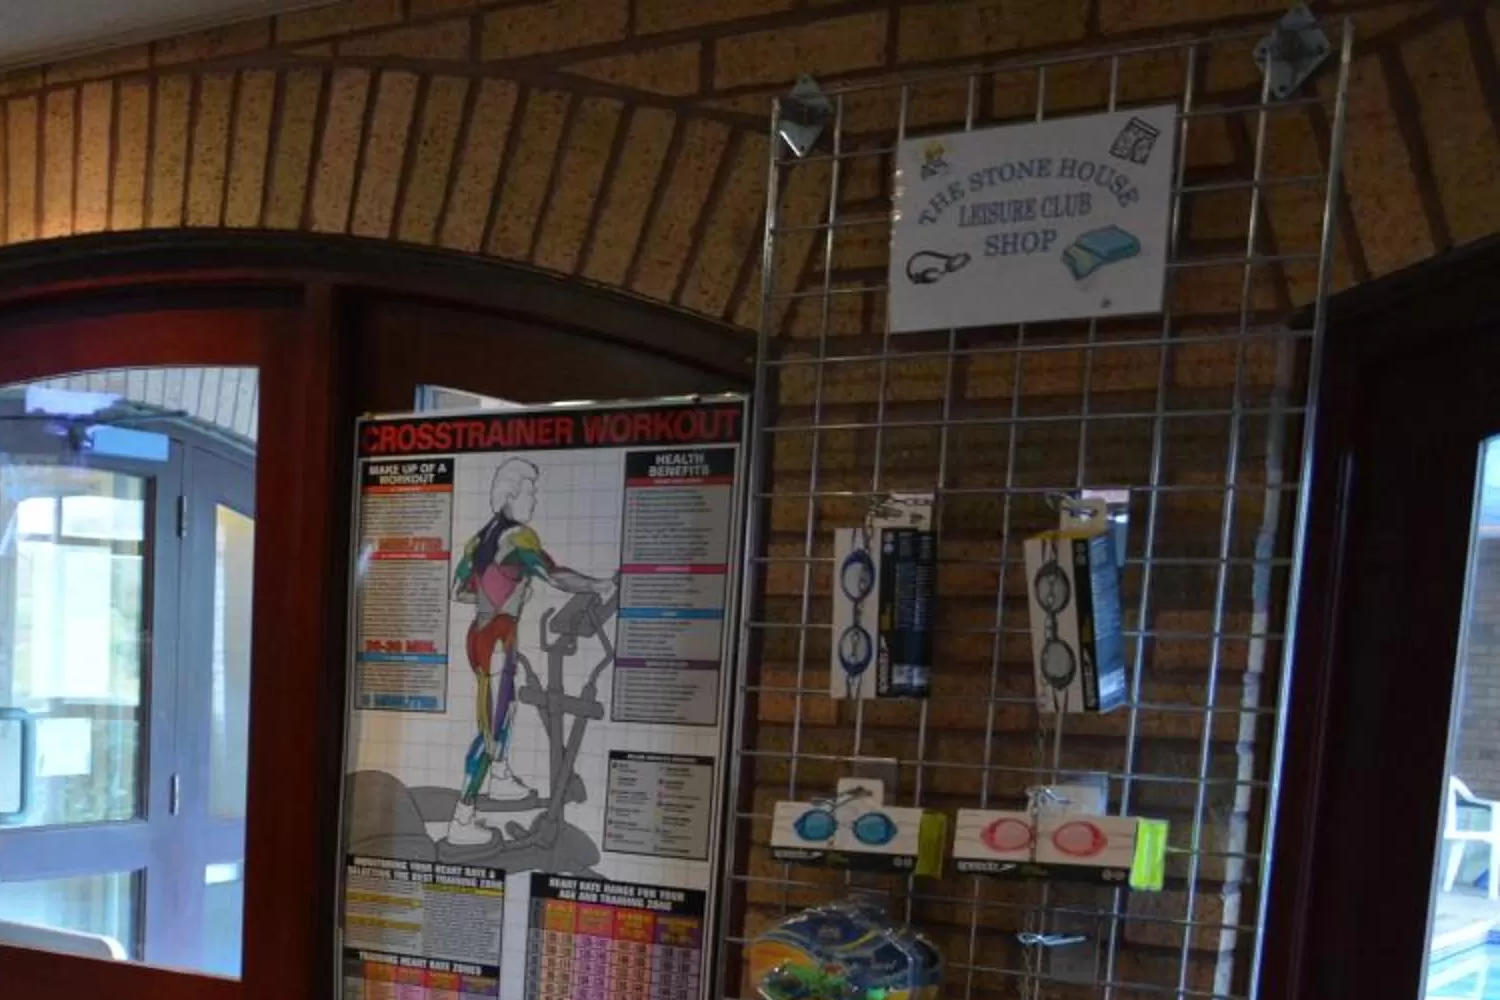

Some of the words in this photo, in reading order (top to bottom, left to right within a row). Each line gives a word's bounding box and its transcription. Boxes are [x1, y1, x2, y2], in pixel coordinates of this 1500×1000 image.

[918, 180, 965, 226] THE
[967, 157, 1053, 193] STONE
[1057, 156, 1142, 208] HOUSE
[957, 201, 1038, 228] LEISURE
[1040, 191, 1093, 219] CLUB
[983, 229, 1058, 257] SHOP
[361, 416, 574, 453] CROSSTRAINER
[583, 408, 740, 444] WORKOUT
[655, 453, 705, 465] HEALTH
